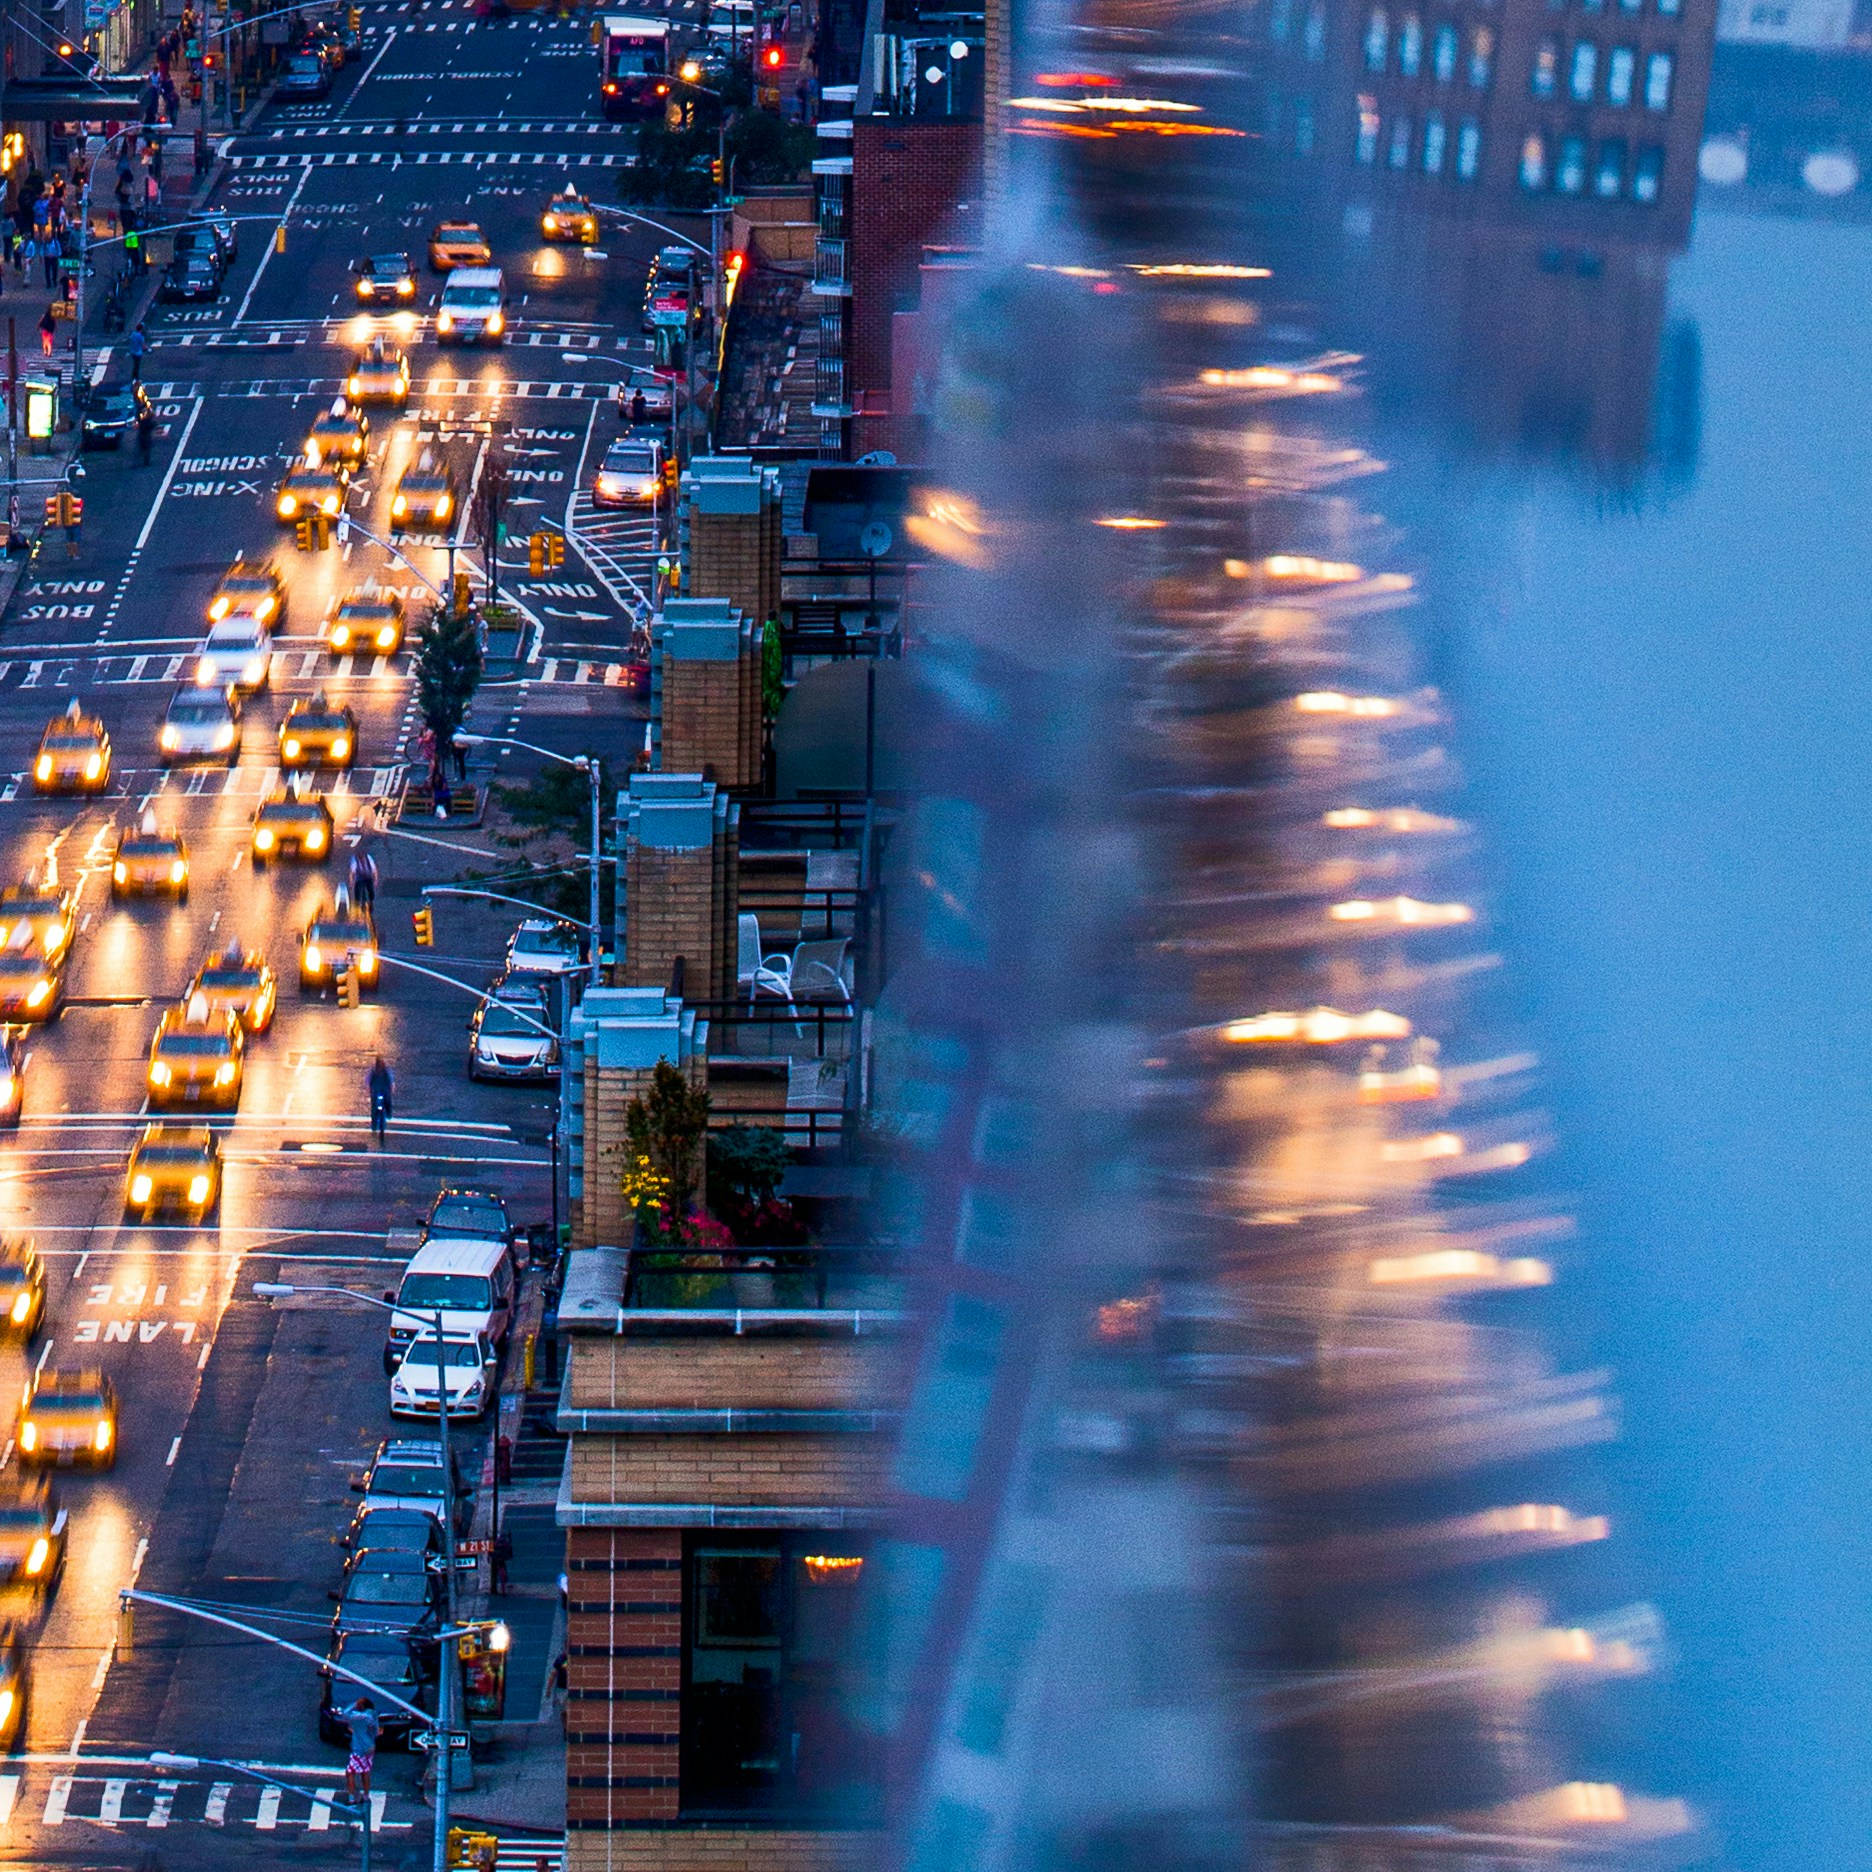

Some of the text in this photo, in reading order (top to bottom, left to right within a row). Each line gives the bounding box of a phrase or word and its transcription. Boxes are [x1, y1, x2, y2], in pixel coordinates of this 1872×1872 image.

[229, 173, 291, 183] ONLY
[229, 186, 283, 197] BUS
[163, 309, 223, 322] BUS
[503, 428, 576, 441] ONLY
[506, 469, 565, 482] ONL
[24, 580, 106, 596] ONLY
[519, 582, 597, 598] ONLY
[21, 604, 96, 620] BUS
[86, 1284, 208, 1307] FIRE
[73, 1320, 197, 1344] LANE
[421, 1736, 436, 1744] ON
